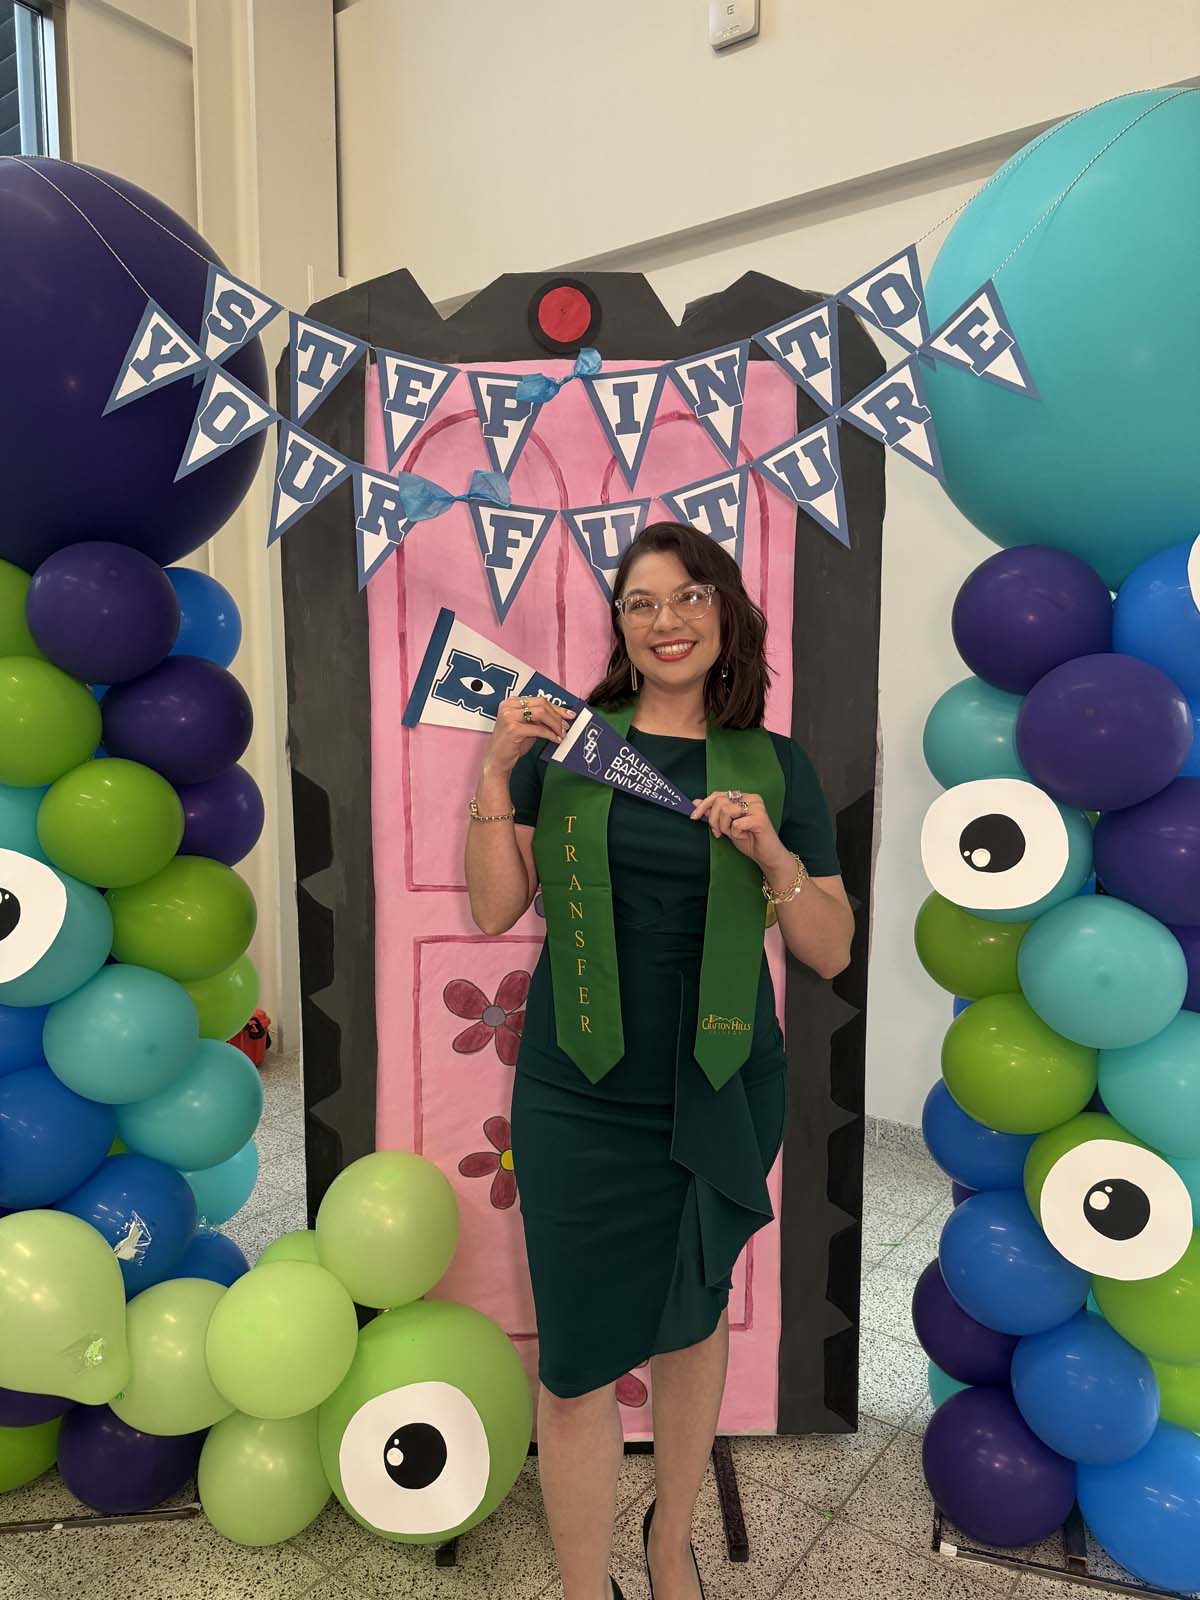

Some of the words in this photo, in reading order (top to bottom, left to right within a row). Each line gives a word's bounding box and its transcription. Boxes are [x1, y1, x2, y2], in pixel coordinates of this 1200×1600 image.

[205, 288, 533, 439] STEP
[612, 272, 922, 437] INTO
[130, 323, 406, 546] YOUR
[484, 305, 1015, 572] FUTURE
[583, 728, 599, 764] CBU
[610, 756, 662, 792] BAPTIST
[619, 746, 682, 802] CALIFORNIA
[603, 768, 678, 806] UNIVERSITY
[563, 815, 593, 1034] TRANSFER
